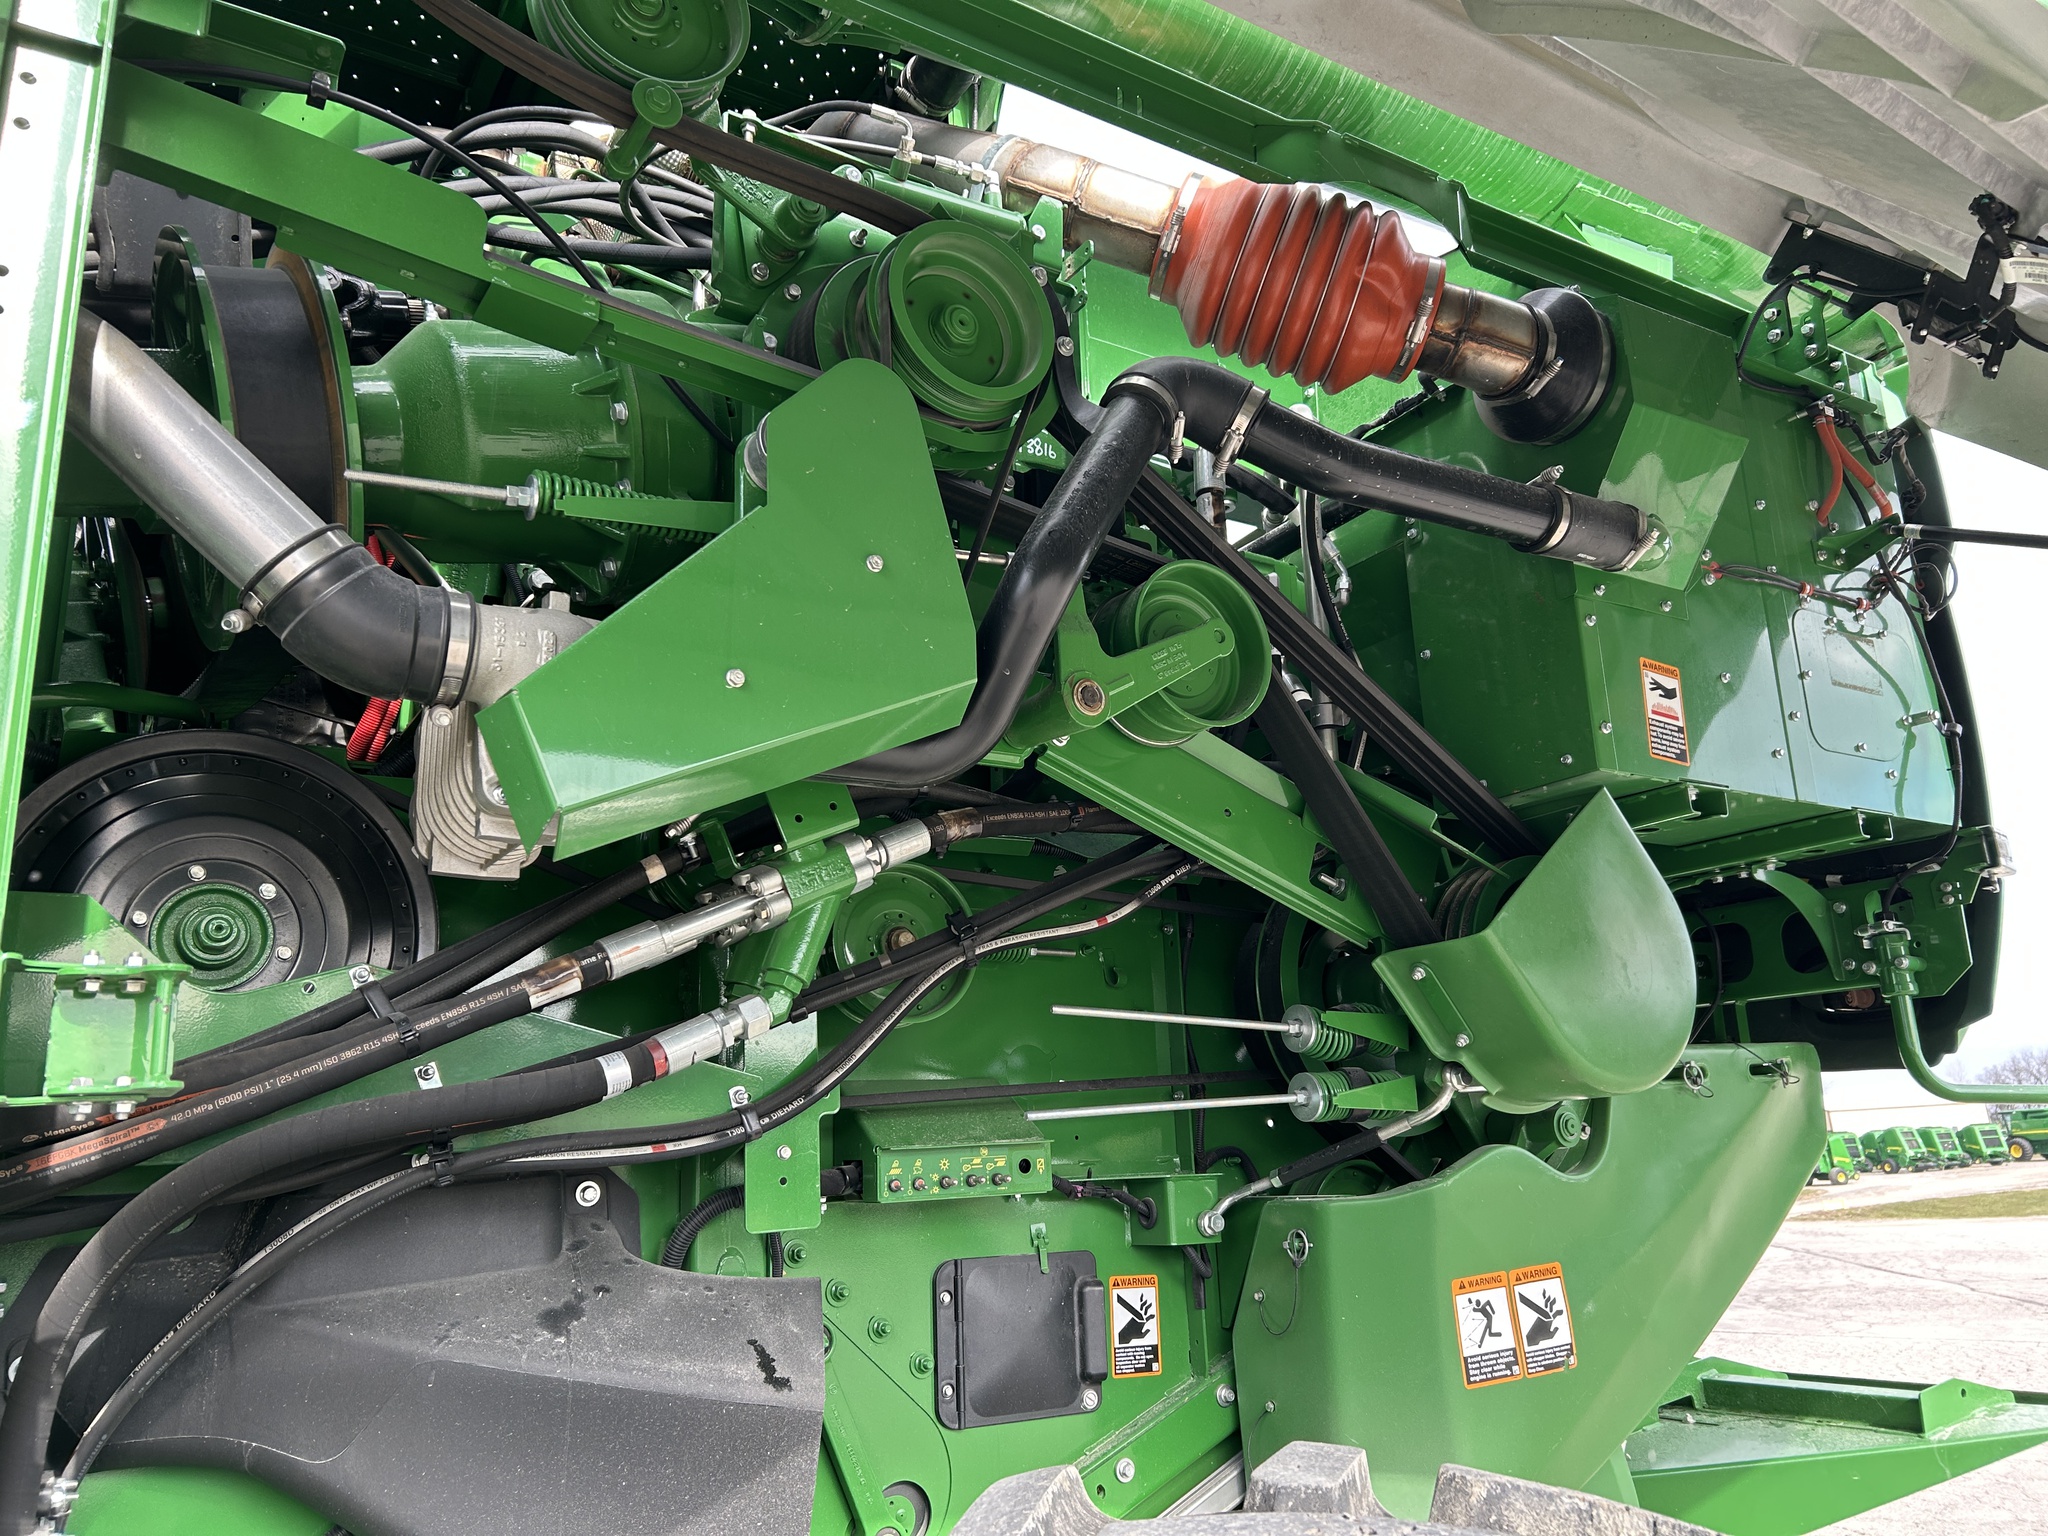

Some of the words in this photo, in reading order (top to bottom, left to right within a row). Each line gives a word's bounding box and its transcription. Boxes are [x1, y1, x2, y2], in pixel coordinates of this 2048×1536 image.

[1647, 661, 1679, 677] WARNING
[1649, 718, 1665, 727] Exhaust
[986, 813, 1007, 822] Exceeds
[1029, 928, 1060, 938] RESISTANT
[170, 1109, 192, 1123] 42.0
[193, 1102, 214, 1116] MPa
[323, 1054, 338, 1068] ISO
[340, 1046, 363, 1062] 3862
[363, 1039, 381, 1053] R15
[381, 1031, 399, 1045] 4SH
[441, 1004, 468, 1021] EN856
[469, 996, 486, 1010] R15
[486, 987, 504, 1002] 4SH
[725, 1126, 745, 1137] T300
[350, 1186, 366, 1198] MAX
[1521, 1266, 1558, 1281] WARNING
[1119, 1276, 1156, 1287] WARNING
[1467, 1274, 1503, 1289] WARNING
[1467, 1355, 1482, 1363] Avoid
[1481, 1352, 1500, 1361] serious
[1480, 1359, 1497, 1367] thrown
[1470, 1374, 1487, 1382] engine
[1492, 1369, 1512, 1377] running.
